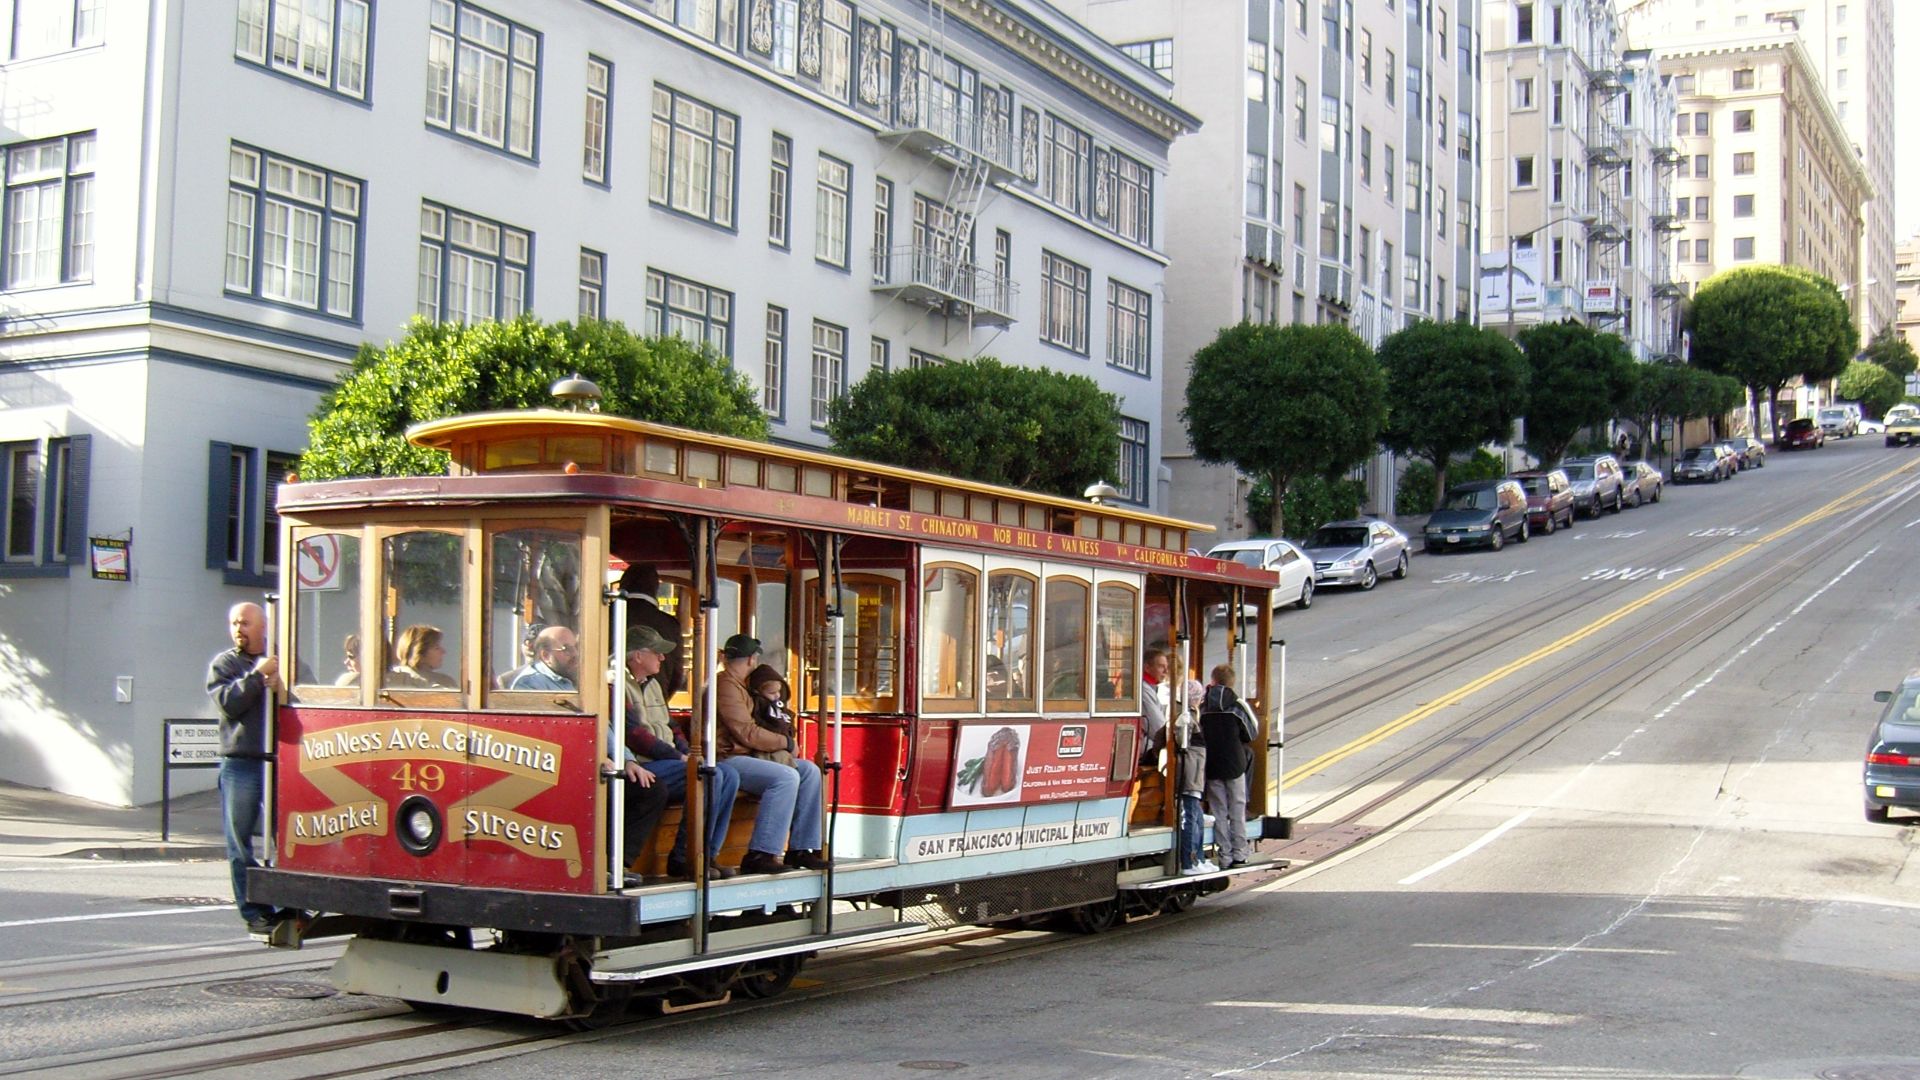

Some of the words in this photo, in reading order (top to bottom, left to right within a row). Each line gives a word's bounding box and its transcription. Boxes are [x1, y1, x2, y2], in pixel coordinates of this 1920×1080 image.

[95, 539, 108, 547] FOR
[109, 541, 125, 549] RENT
[847, 507, 891, 528] MARKET
[921, 518, 979, 539] CHINATOWN
[993, 528, 1012, 544] NOB
[1017, 533, 1038, 548] HILL
[1061, 538, 1077, 553] VAN
[1079, 540, 1100, 556] NESS
[1134, 548, 1178, 568] CALIFORNIA
[1215, 561, 1227, 574] 49
[184, 729, 196, 737] PED
[182, 750, 193, 758] USE
[303, 737, 335, 761] Van
[335, 730, 383, 756] Ness
[441, 727, 557, 773] California
[391, 762, 446, 793] 49
[1026, 765, 1043, 775] JUST
[1044, 764, 1066, 773] FOLLOW
[1067, 763, 1079, 771] THE
[295, 814, 308, 838] &
[311, 804, 380, 838] Market
[464, 810, 564, 850] Streets
[918, 838, 945, 857] SAN
[948, 831, 1012, 853] FRANCISCO
[1015, 825, 1069, 846] MUNICIPAL
